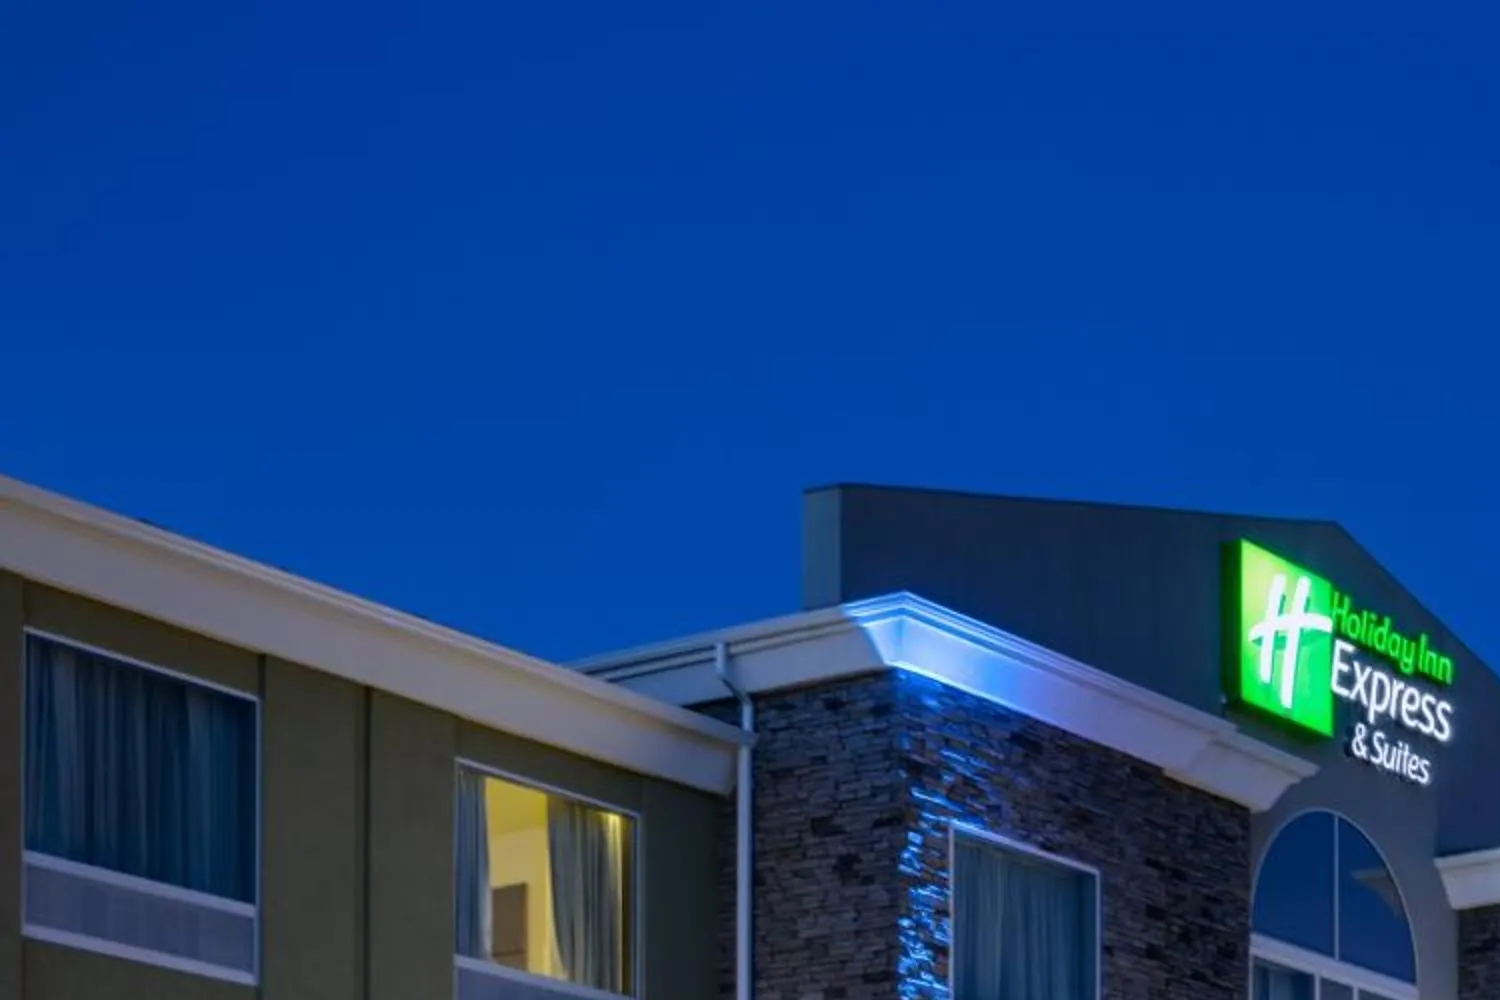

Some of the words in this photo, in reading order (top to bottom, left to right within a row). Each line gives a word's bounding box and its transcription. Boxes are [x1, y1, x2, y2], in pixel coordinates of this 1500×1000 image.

[1331, 592, 1416, 674] Holiday
[1418, 633, 1453, 684] Inn
[1331, 638, 1453, 742] Express
[1350, 723, 1369, 758] &
[1370, 732, 1431, 785] Suites
